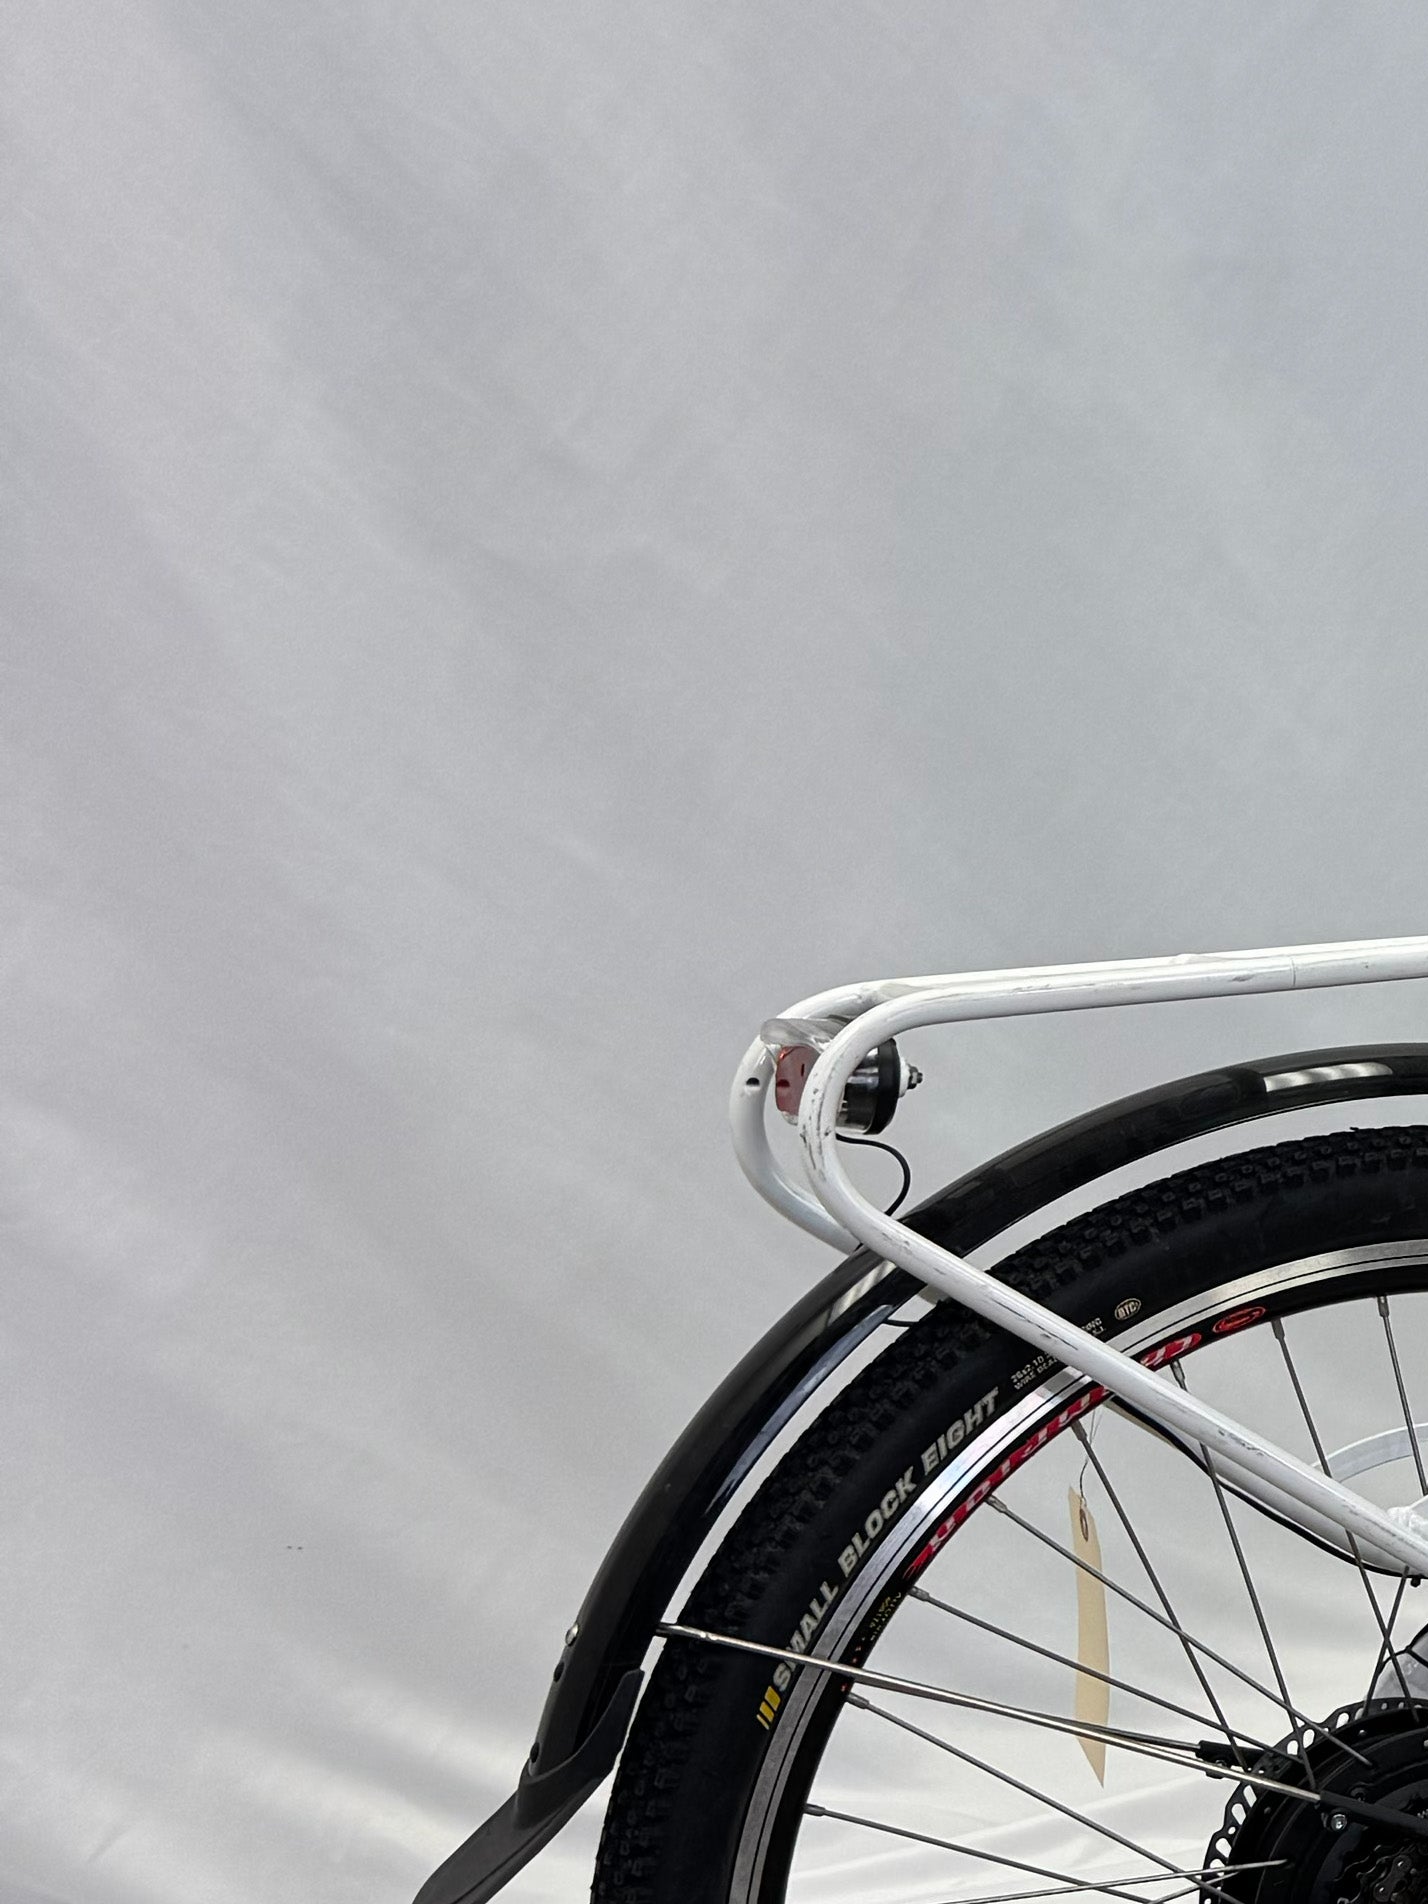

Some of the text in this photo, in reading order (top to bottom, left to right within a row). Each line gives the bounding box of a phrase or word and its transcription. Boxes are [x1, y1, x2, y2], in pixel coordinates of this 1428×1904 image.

[772, 1581, 840, 1692] SMALL
[837, 1466, 918, 1578] BLOCK
[920, 1387, 999, 1476] EIGHT
